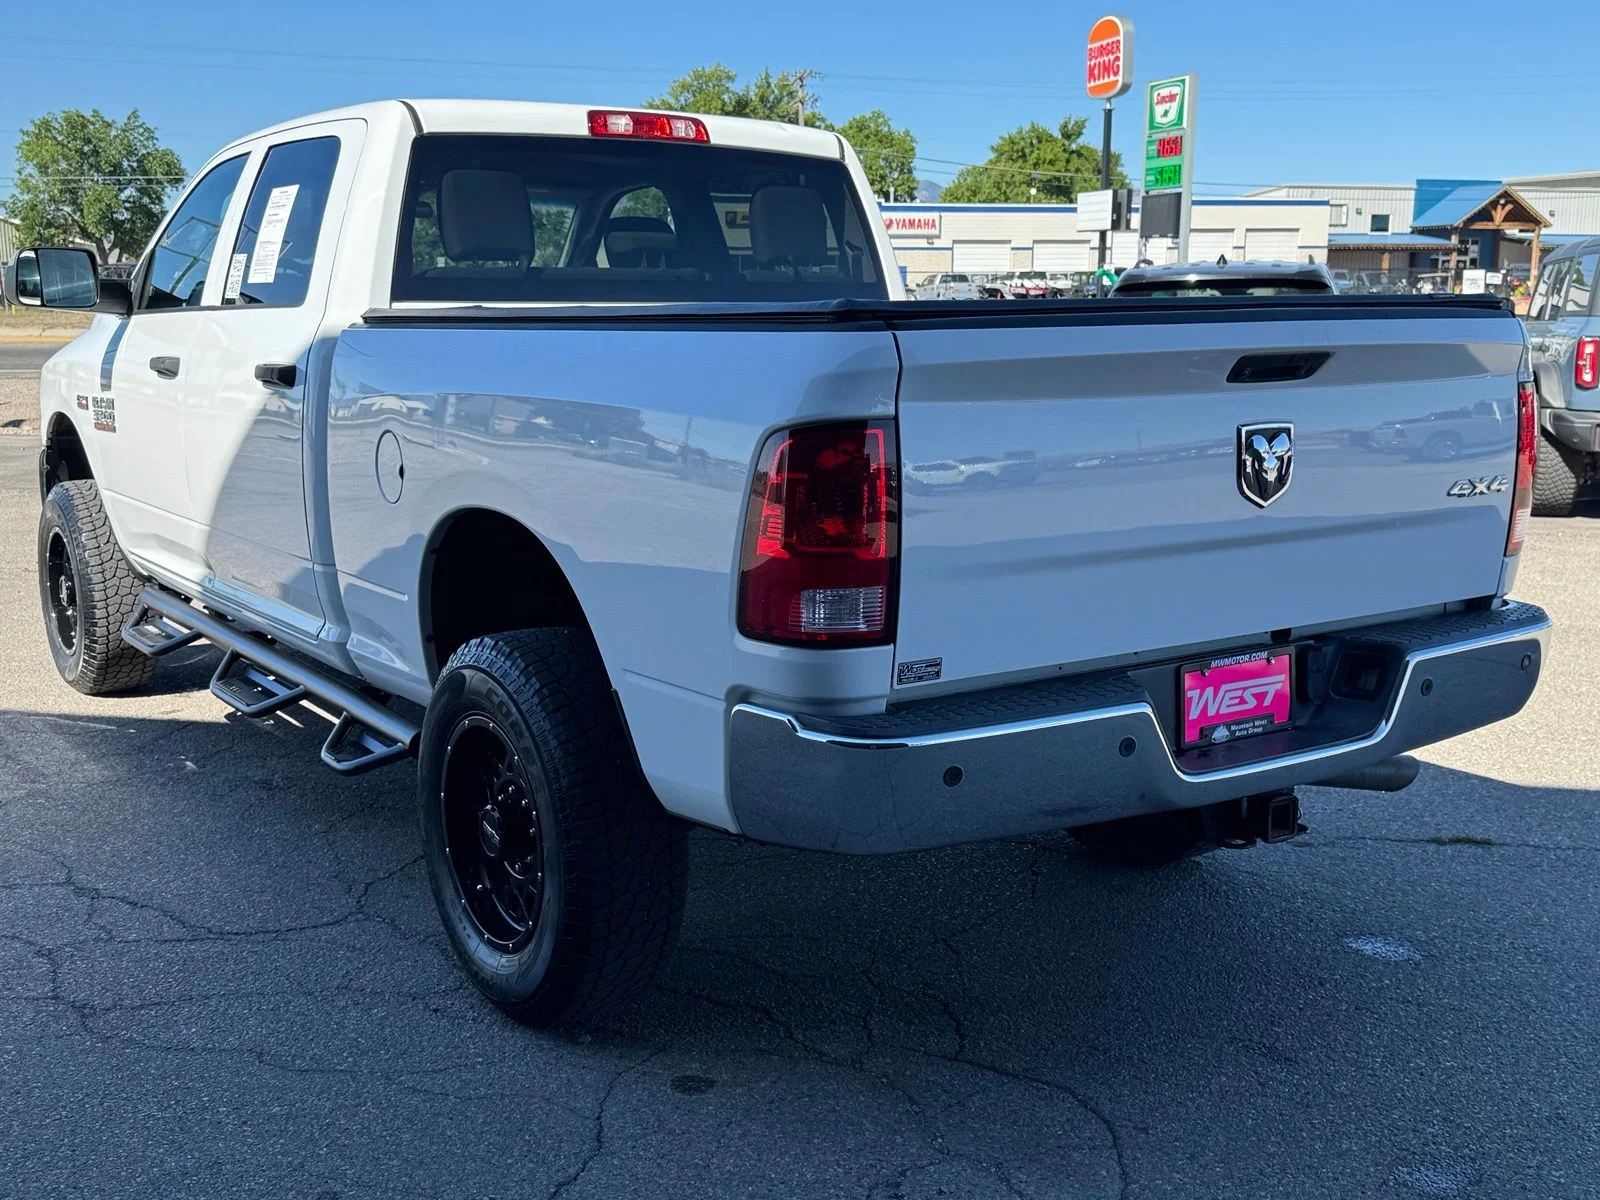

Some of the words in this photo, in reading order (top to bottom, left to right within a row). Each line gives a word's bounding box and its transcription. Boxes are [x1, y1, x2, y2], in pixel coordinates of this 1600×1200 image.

[1088, 39, 1121, 62] BURGER
[1088, 55, 1120, 84] KING
[895, 217, 937, 231] YAMAHA
[1210, 651, 1268, 668] MWMOTOR.COM
[1230, 722, 1254, 731] Mountain
[1254, 719, 1268, 727] West
[1248, 726, 1263, 734] Group
